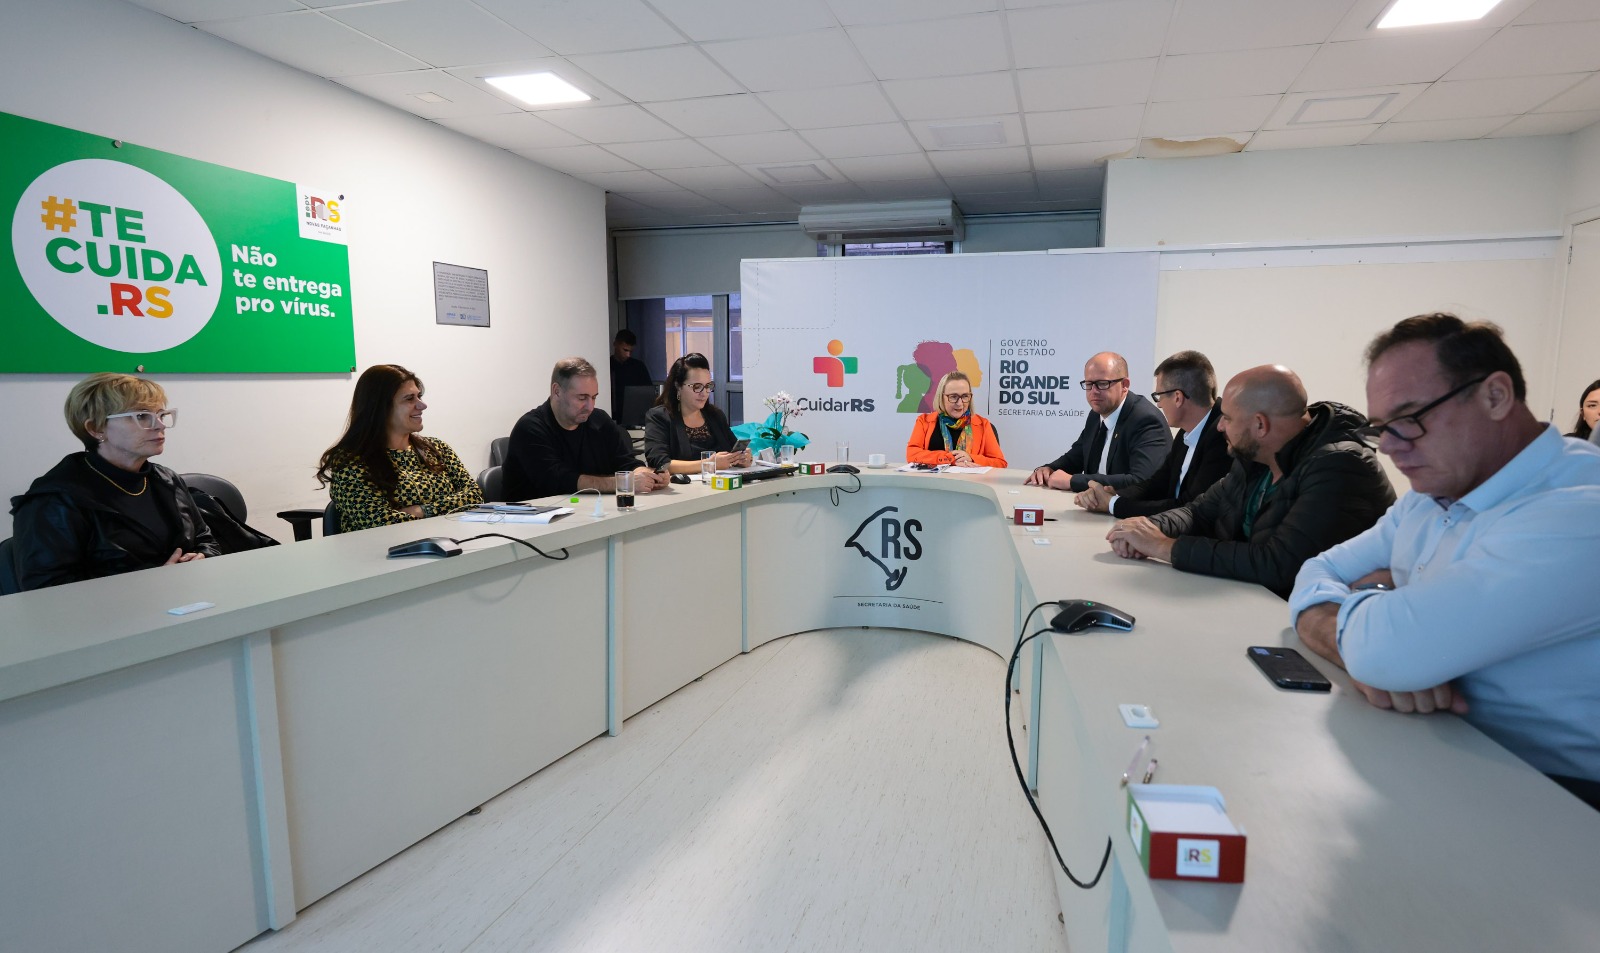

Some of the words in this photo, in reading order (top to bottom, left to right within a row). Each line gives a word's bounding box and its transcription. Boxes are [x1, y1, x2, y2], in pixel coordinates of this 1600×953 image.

[41, 195, 146, 243] #TE
[45, 237, 208, 287] CUIDA
[231, 243, 277, 267] Não
[233, 268, 256, 288] te
[263, 275, 342, 299] entrega
[97, 283, 174, 319] .RS
[236, 296, 275, 314] pro
[280, 296, 336, 318] vírus.
[1000, 339, 1048, 347] GOVERNO
[1000, 348, 1014, 356] DO
[1017, 348, 1056, 356] ESTADO
[1000, 359, 1029, 374] RIO
[999, 375, 1070, 390] GRANDE
[796, 397, 876, 413] CuidarRS
[999, 390, 1024, 405] DO
[1027, 391, 1060, 405] SUL
[998, 408, 1043, 416] SECRETARIA
[1045, 409, 1057, 417] DA
[1058, 408, 1085, 417] SAÚDE
[881, 517, 922, 560] RS
[902, 603, 921, 611] SAÚDE
